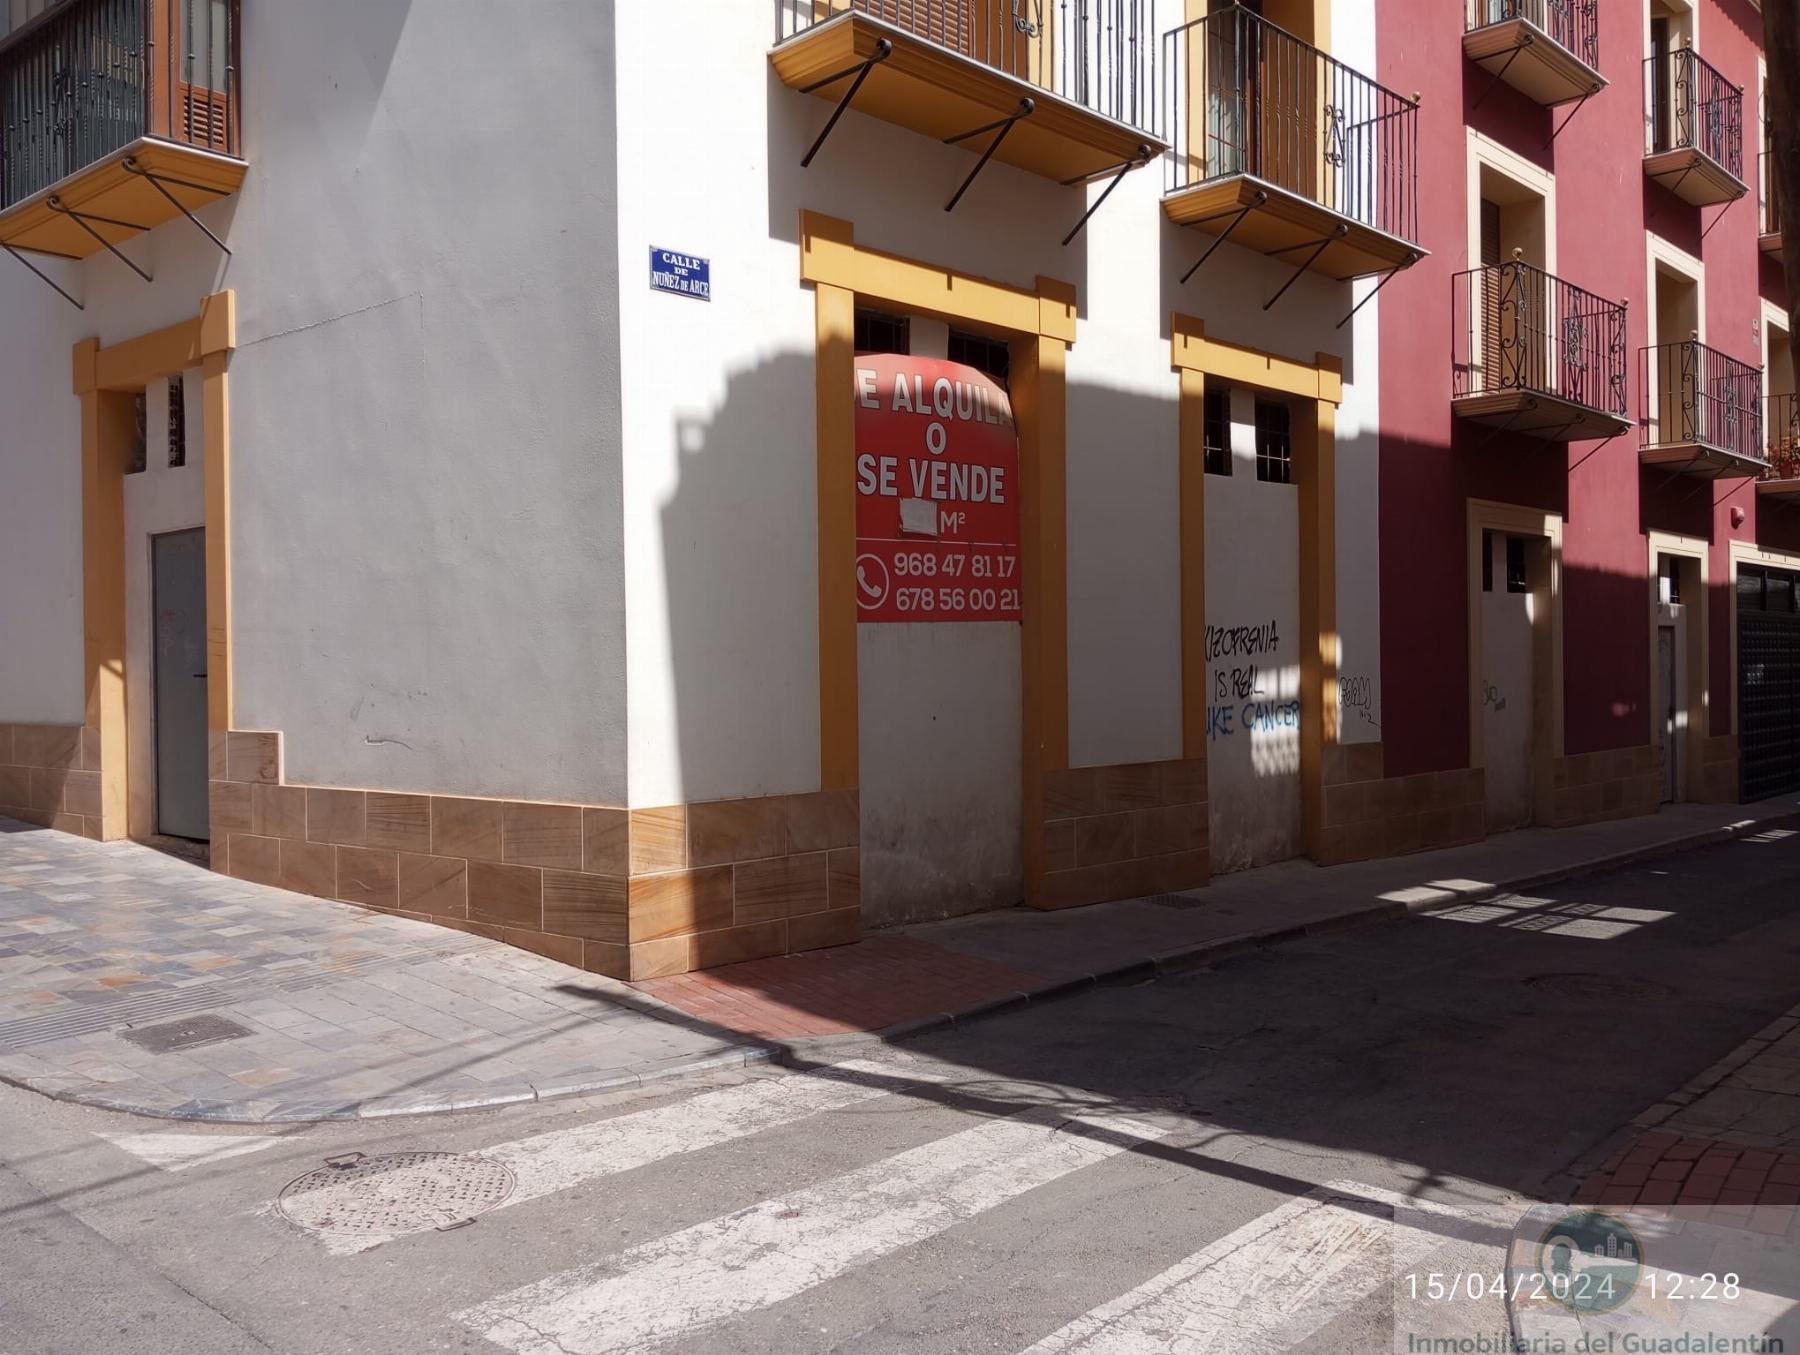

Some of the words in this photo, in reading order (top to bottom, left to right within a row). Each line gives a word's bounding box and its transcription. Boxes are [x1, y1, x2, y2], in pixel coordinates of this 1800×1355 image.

[662, 252, 701, 271] CALLE
[674, 266, 689, 277] DE
[680, 279, 689, 292] DE
[689, 279, 709, 297] ARCE
[926, 422, 947, 455] O
[857, 453, 898, 497] SE
[909, 458, 1006, 504] VENDE
[893, 552, 937, 577] 968
[941, 554, 966, 577] 47
[971, 555, 993, 578] 81
[997, 555, 1017, 578] 17
[896, 588, 935, 611] 678
[939, 588, 966, 611] 56
[969, 588, 996, 611] 00
[1000, 588, 1021, 611] 21
[1214, 669, 1228, 702] IS
[1230, 664, 1265, 699] REAL
[1206, 703, 1235, 741] IKE
[1241, 699, 1300, 732] CANCER
